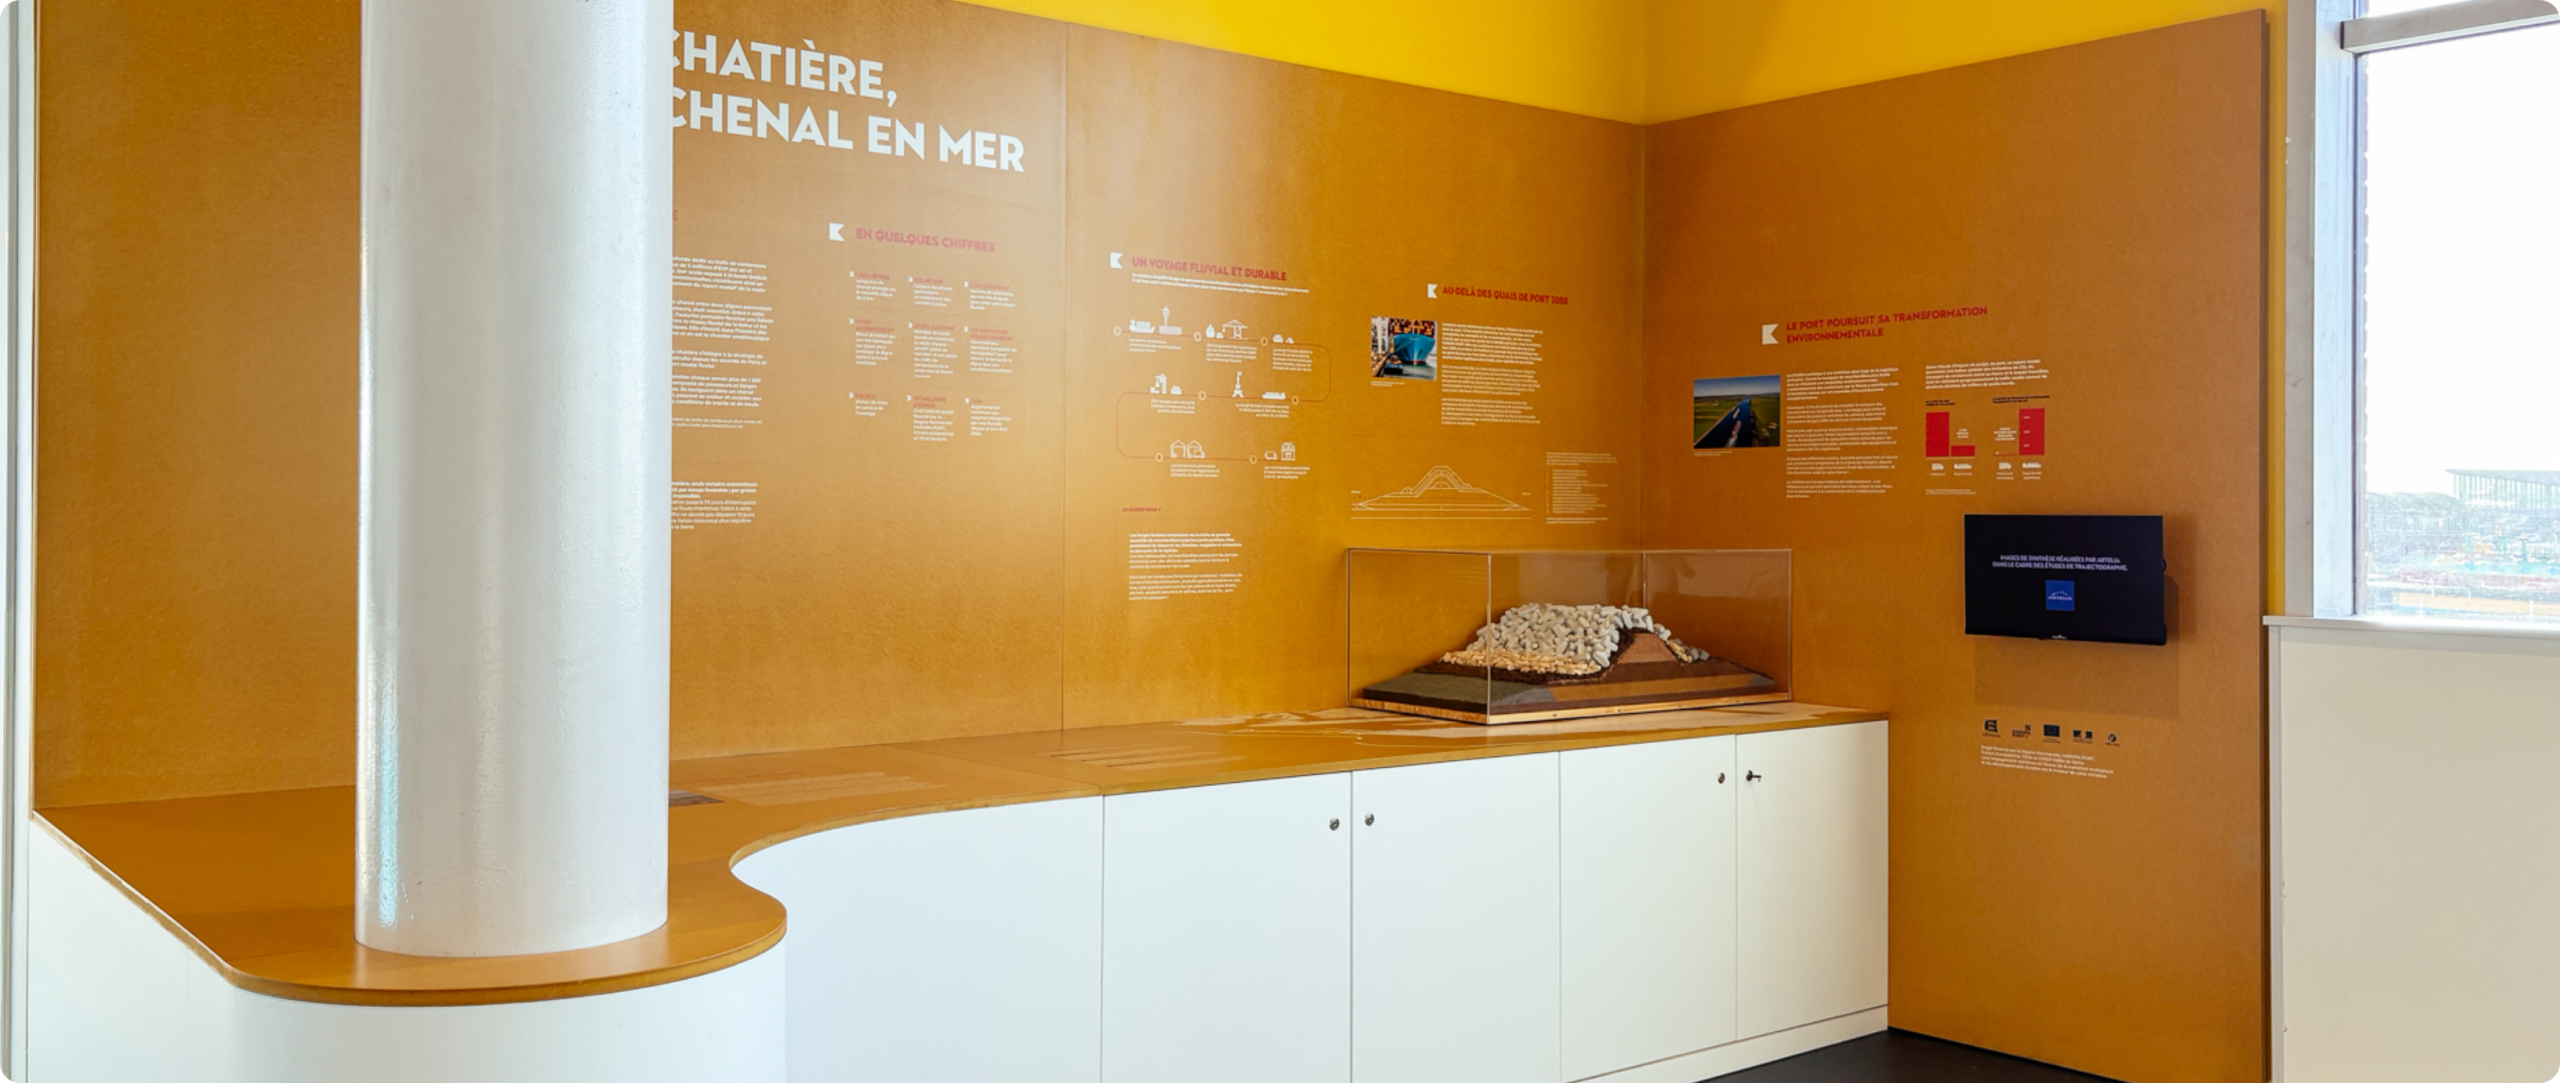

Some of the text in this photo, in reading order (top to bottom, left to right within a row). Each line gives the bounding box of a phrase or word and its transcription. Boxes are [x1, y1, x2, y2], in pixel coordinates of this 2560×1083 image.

[868, 116, 925, 160] EN
[939, 125, 1024, 172] MER
[856, 228, 995, 252] EN QUELQUES CHIFFRES
[1132, 257, 1286, 281] UN VOYAGE FLUVIAL ET DURABLE
[1443, 287, 1568, 304] AU-DELÀ DES QUAIS DE PORT 2000
[1786, 307, 1987, 330] LE PORT POURSUIT SA TRANSFORMATION
[1787, 328, 1883, 343] ENVIRONNEMENTALE
